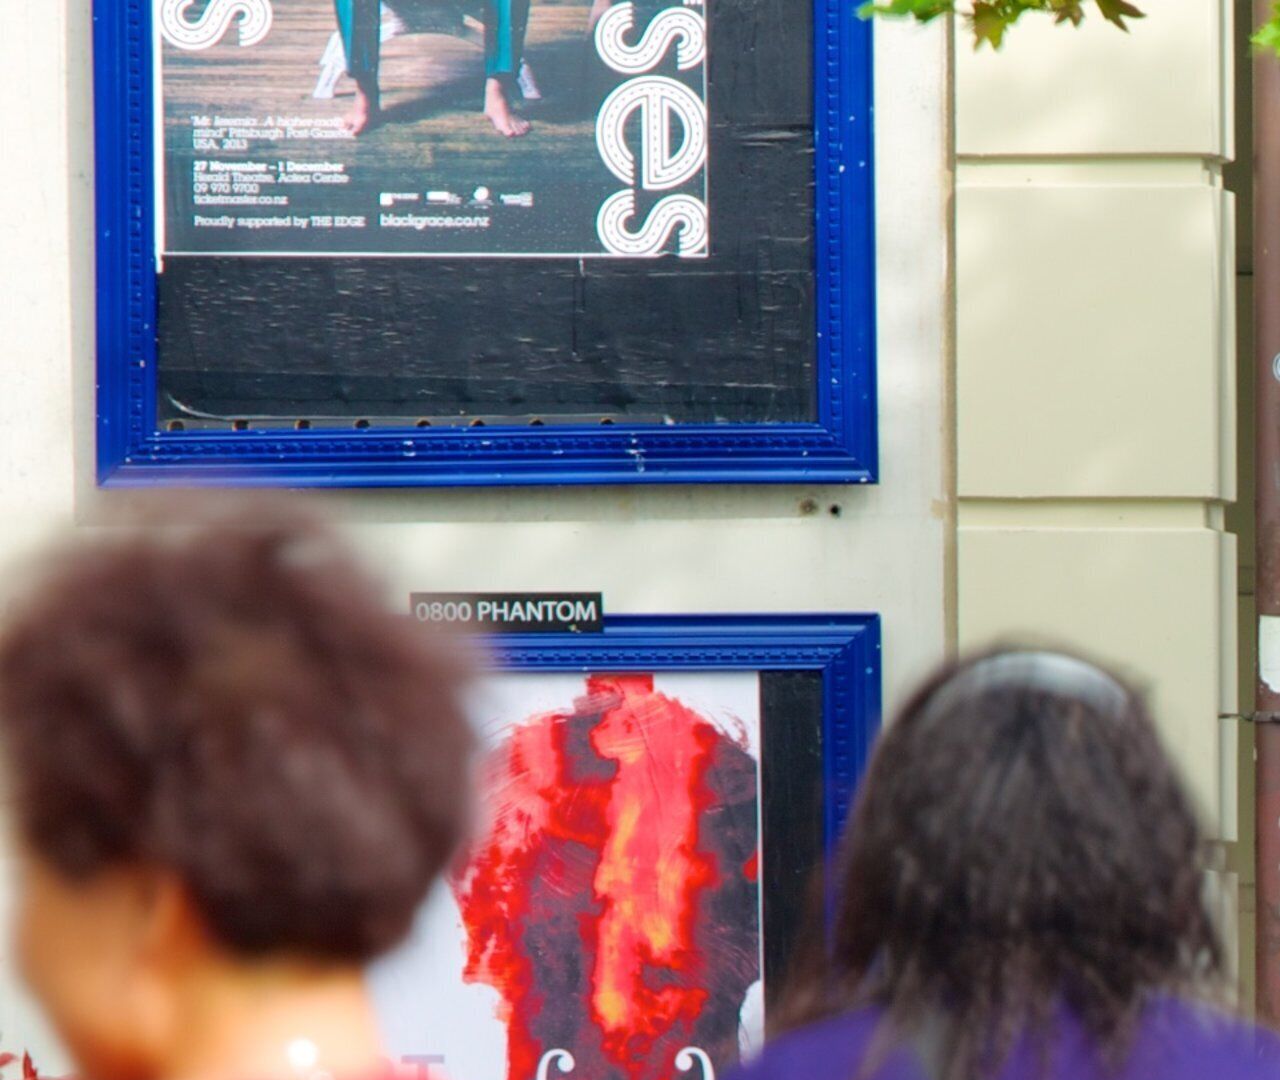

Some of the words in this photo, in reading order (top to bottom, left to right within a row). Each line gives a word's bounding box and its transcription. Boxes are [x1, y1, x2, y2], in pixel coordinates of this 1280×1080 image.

[193, 161, 207, 172] 27
[209, 161, 267, 172] November
[286, 161, 344, 172] December
[312, 173, 349, 184] Centre
[193, 195, 288, 205] ticketmaster.co.nz
[194, 215, 235, 228] Proudly
[237, 215, 291, 229] supported
[293, 215, 310, 228] by
[311, 215, 332, 227] THE
[334, 215, 366, 226] EDGE
[380, 214, 490, 230] blackgrace.co.nz
[416, 602, 471, 621] 0800
[477, 601, 597, 622] PHANTOM
